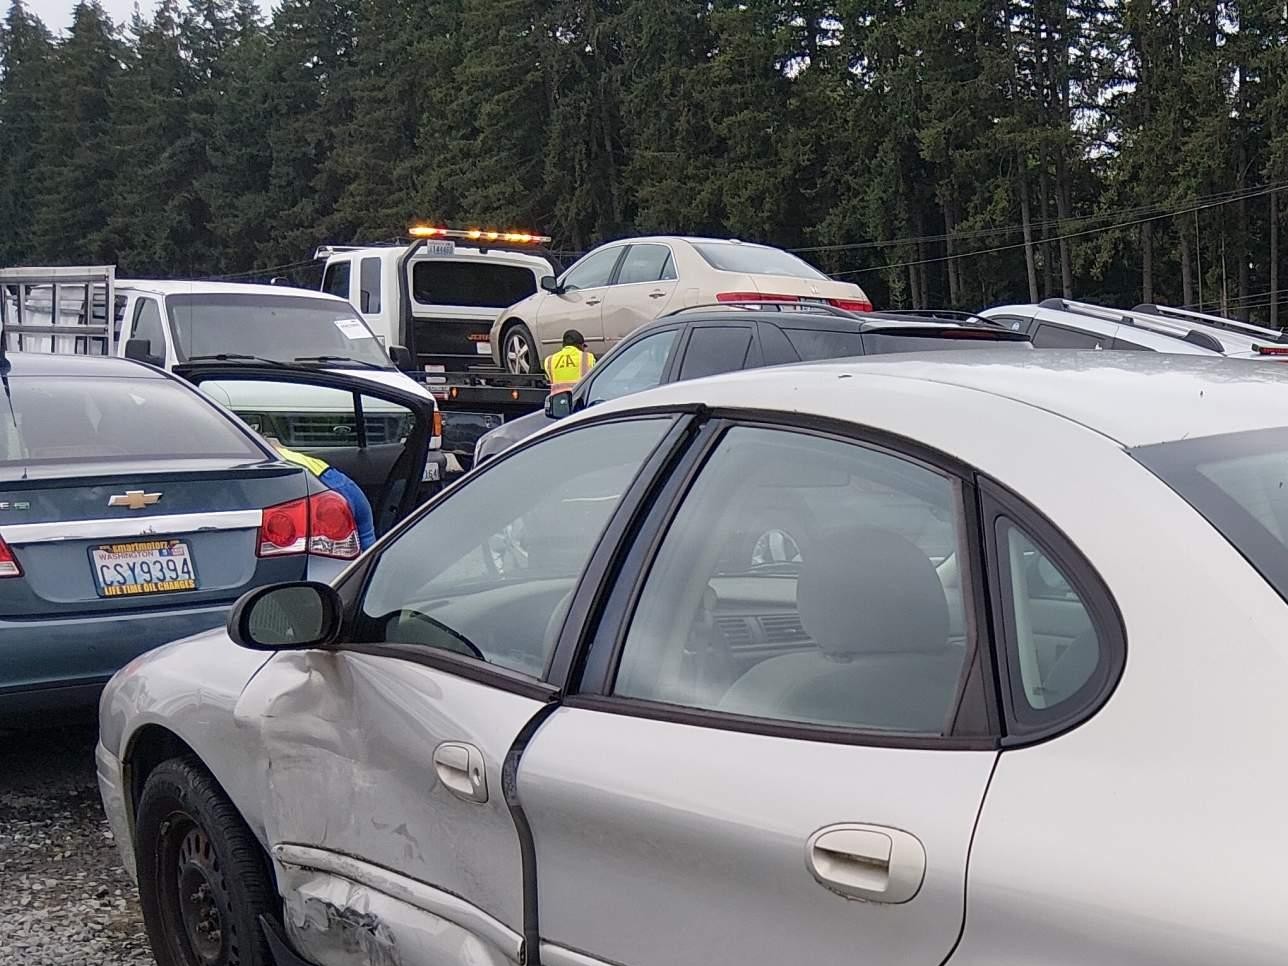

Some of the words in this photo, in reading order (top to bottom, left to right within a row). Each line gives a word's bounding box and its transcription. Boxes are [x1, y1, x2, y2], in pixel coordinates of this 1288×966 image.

[98, 551, 154, 561] WASHINGTON
[100, 557, 192, 586] CSY9394
[143, 582, 157, 593] OIL
[157, 579, 195, 591] CHANGES
